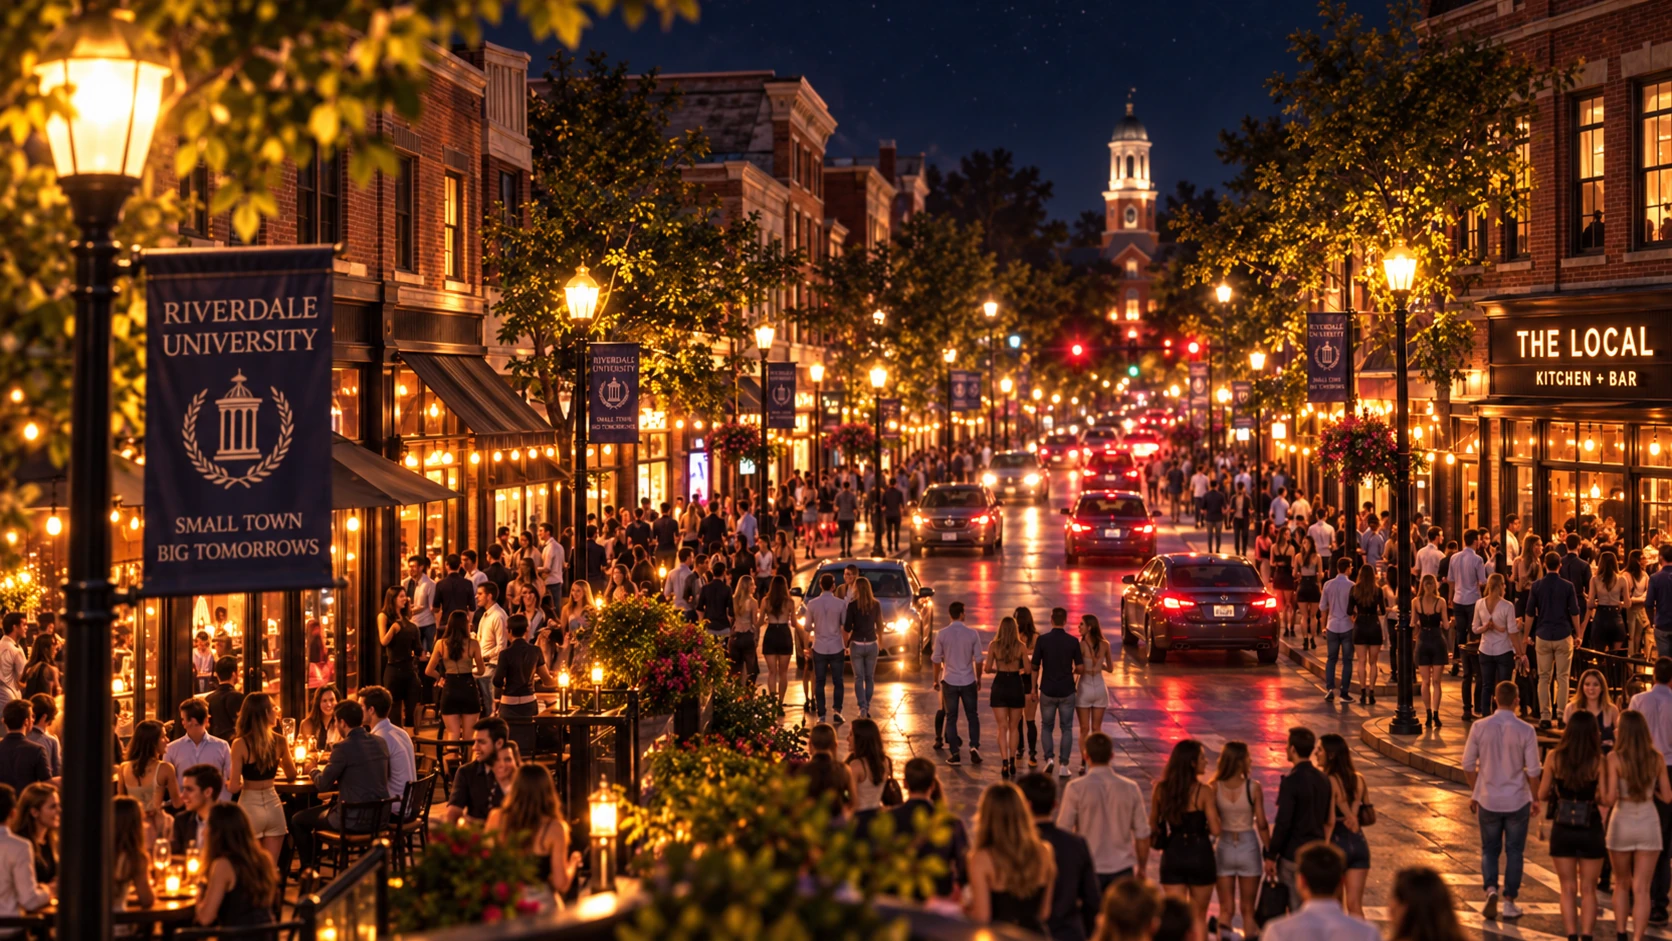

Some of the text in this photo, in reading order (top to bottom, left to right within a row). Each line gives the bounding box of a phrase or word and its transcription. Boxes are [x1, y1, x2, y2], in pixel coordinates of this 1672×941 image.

[163, 296, 318, 324] RIVERDALE
[163, 328, 318, 356] UNIVERSITY
[1517, 326, 1654, 358] THE LOCAL
[1536, 371, 1637, 386] KITCHEN + BAR
[175, 512, 303, 534] SMALL TOWN
[157, 538, 319, 562] BIG TOMORROWS
